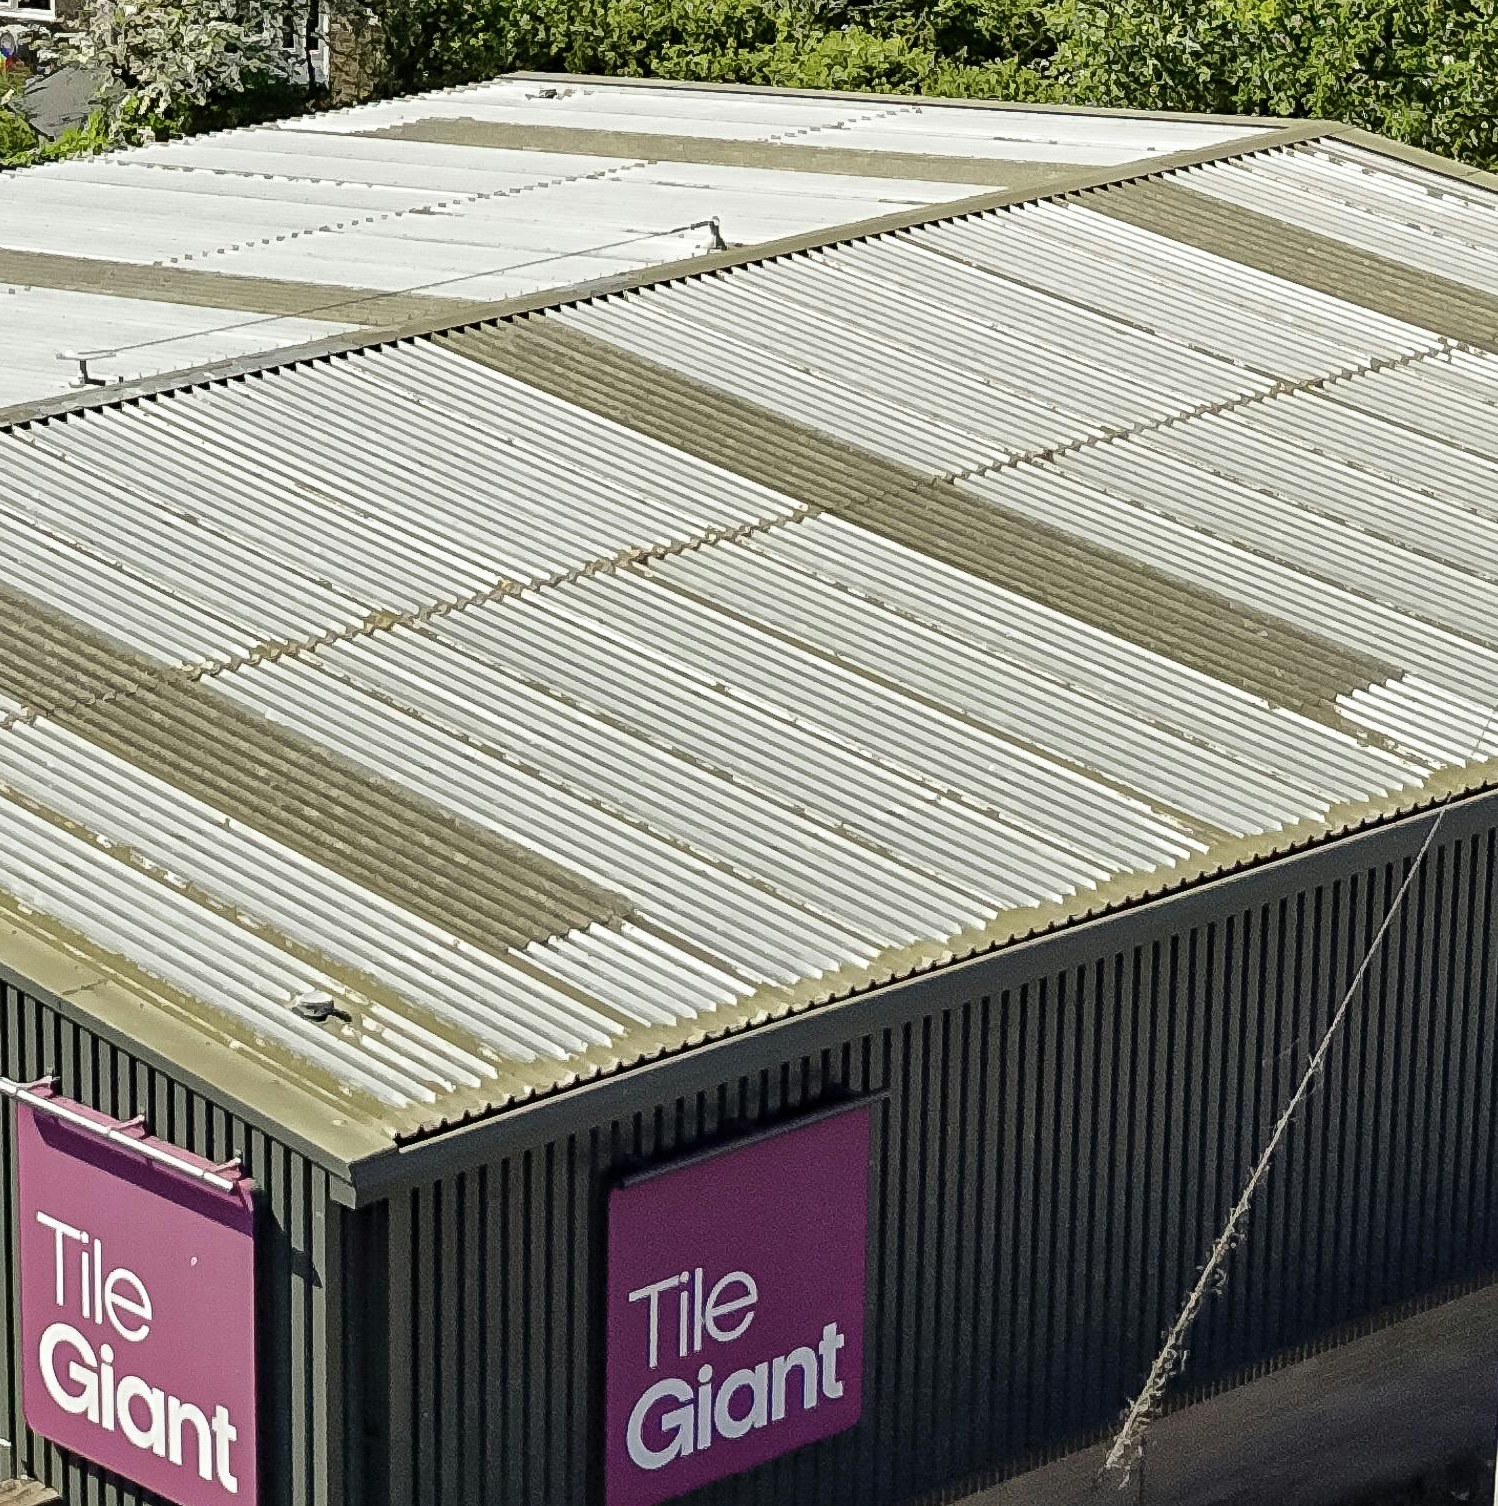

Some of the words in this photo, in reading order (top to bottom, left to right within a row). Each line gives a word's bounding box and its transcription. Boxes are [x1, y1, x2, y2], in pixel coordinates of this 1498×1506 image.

[36, 1211, 152, 1342] Tile
[629, 1267, 758, 1369] Tile
[39, 1323, 238, 1493] Giant
[626, 1322, 844, 1469] Giant
